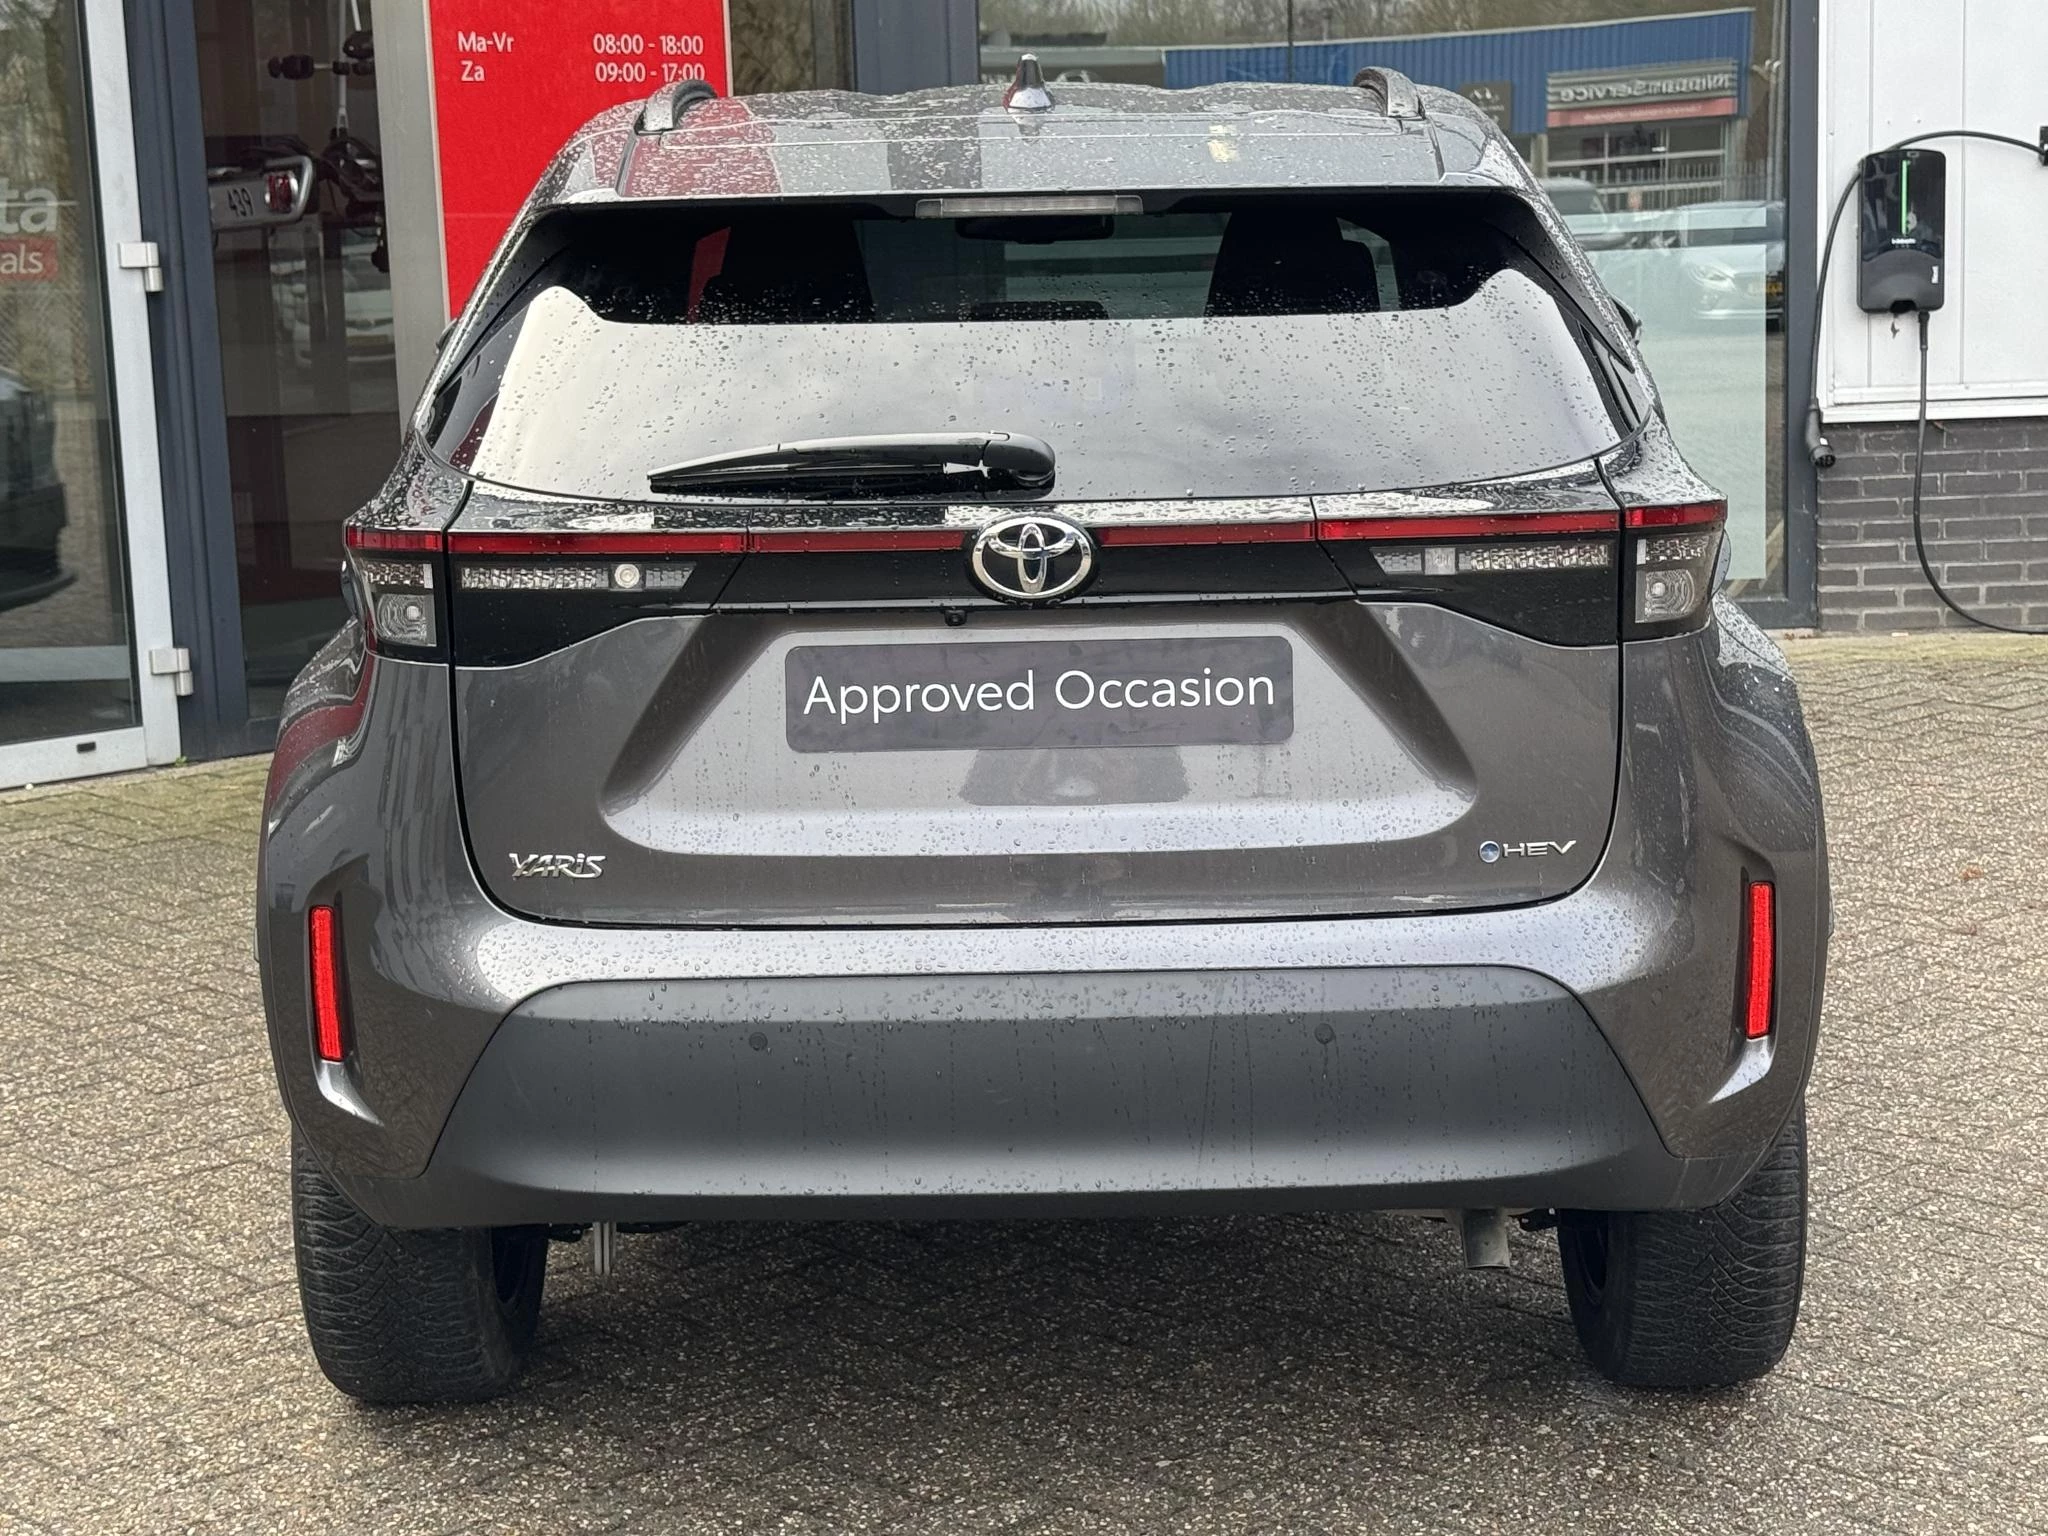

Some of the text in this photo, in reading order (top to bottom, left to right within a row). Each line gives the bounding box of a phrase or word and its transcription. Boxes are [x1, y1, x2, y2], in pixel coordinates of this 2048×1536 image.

[457, 31, 514, 52] Ma-Vr
[593, 33, 644, 55] 08:00
[660, 35, 703, 55] 18:00
[461, 60, 485, 82] Za
[595, 63, 646, 82] 09:00
[663, 63, 705, 82] 17:00
[227, 187, 254, 217] 439
[803, 667, 1275, 725] Approved Occasion
[1502, 840, 1577, 857] HEV
